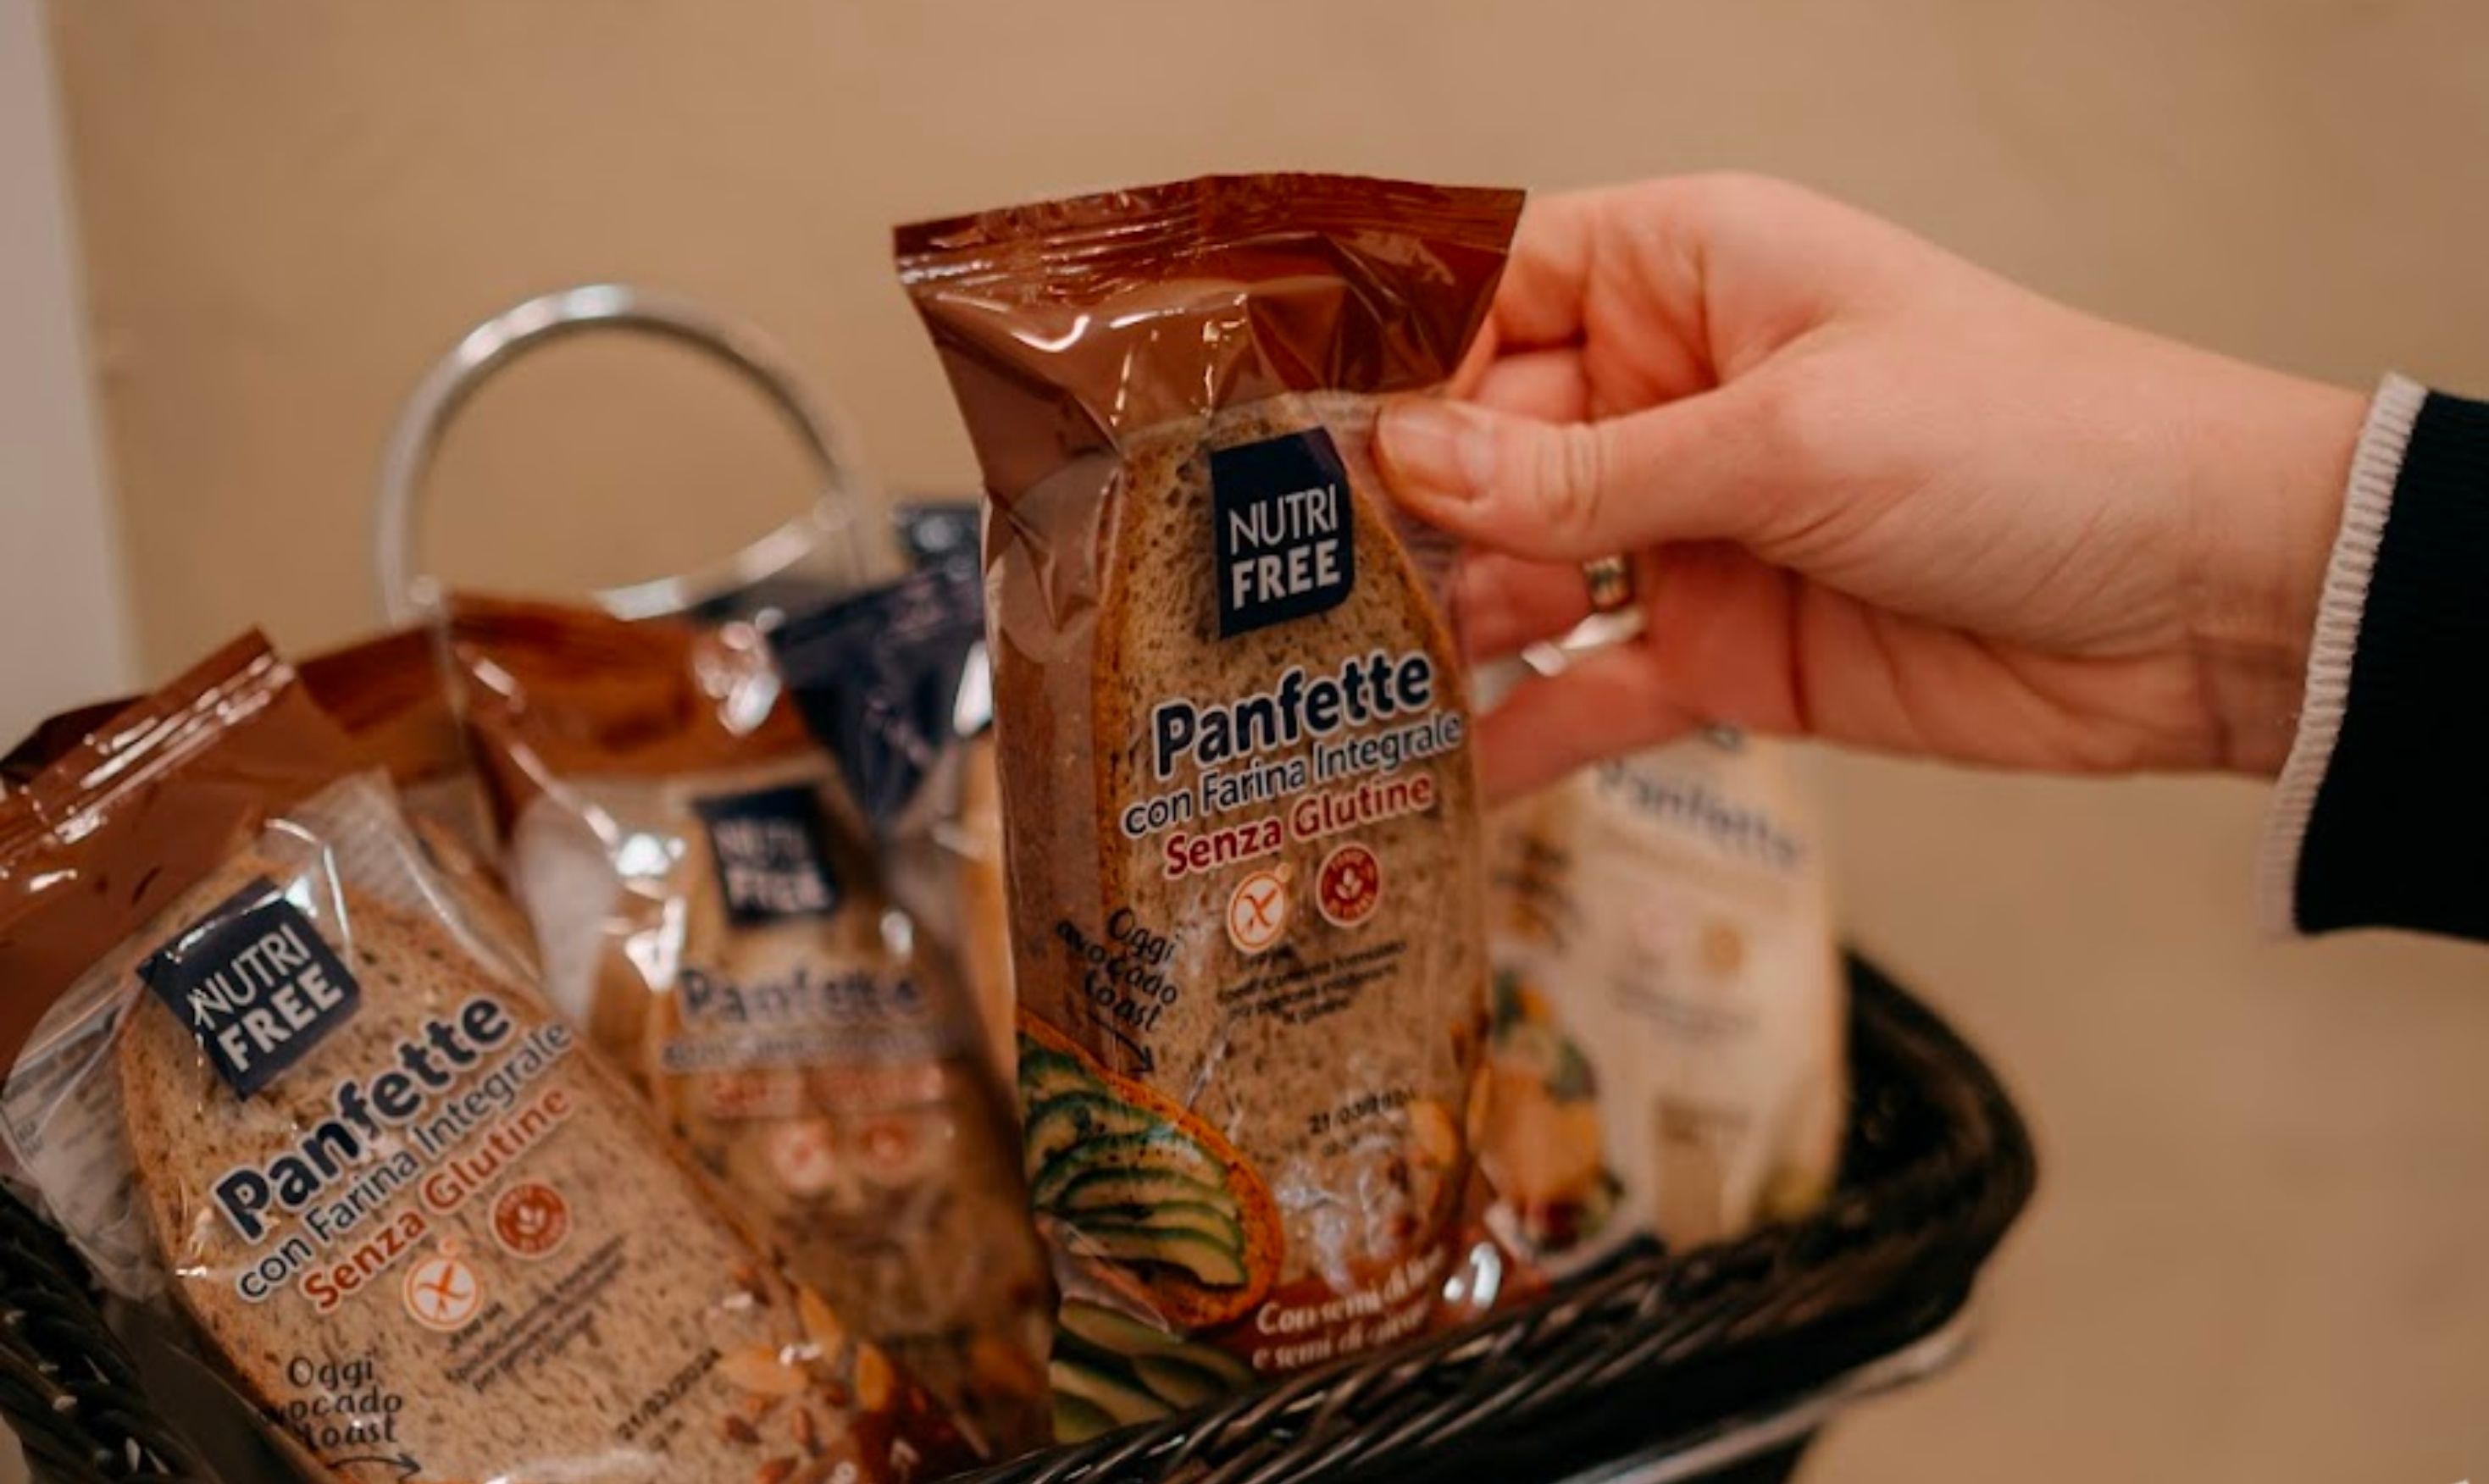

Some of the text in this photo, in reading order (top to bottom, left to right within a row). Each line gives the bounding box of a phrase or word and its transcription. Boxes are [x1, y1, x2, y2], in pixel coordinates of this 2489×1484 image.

[1227, 483, 1339, 556] NUTRI
[1230, 538, 1343, 611] FREE
[1154, 653, 1433, 778] Panfette
[1123, 713, 1463, 836] con Farina Integrale
[1163, 773, 1433, 878] Senza Glutine
[193, 921, 311, 1033] NUTRI
[1056, 920, 1178, 1005] avocado
[1107, 906, 1176, 965] Oggi
[217, 966, 342, 1073] FREE
[1084, 970, 1161, 1033] toast
[214, 995, 512, 1239] Panfette
[240, 1245, 313, 1299] con
[305, 1149, 420, 1245] Farina
[413, 1022, 572, 1155] Integrale
[302, 1219, 428, 1312] Senza
[425, 1087, 572, 1216] Glutine
[287, 1345, 374, 1391] Oggi
[1256, 1301, 1319, 1336] Con
